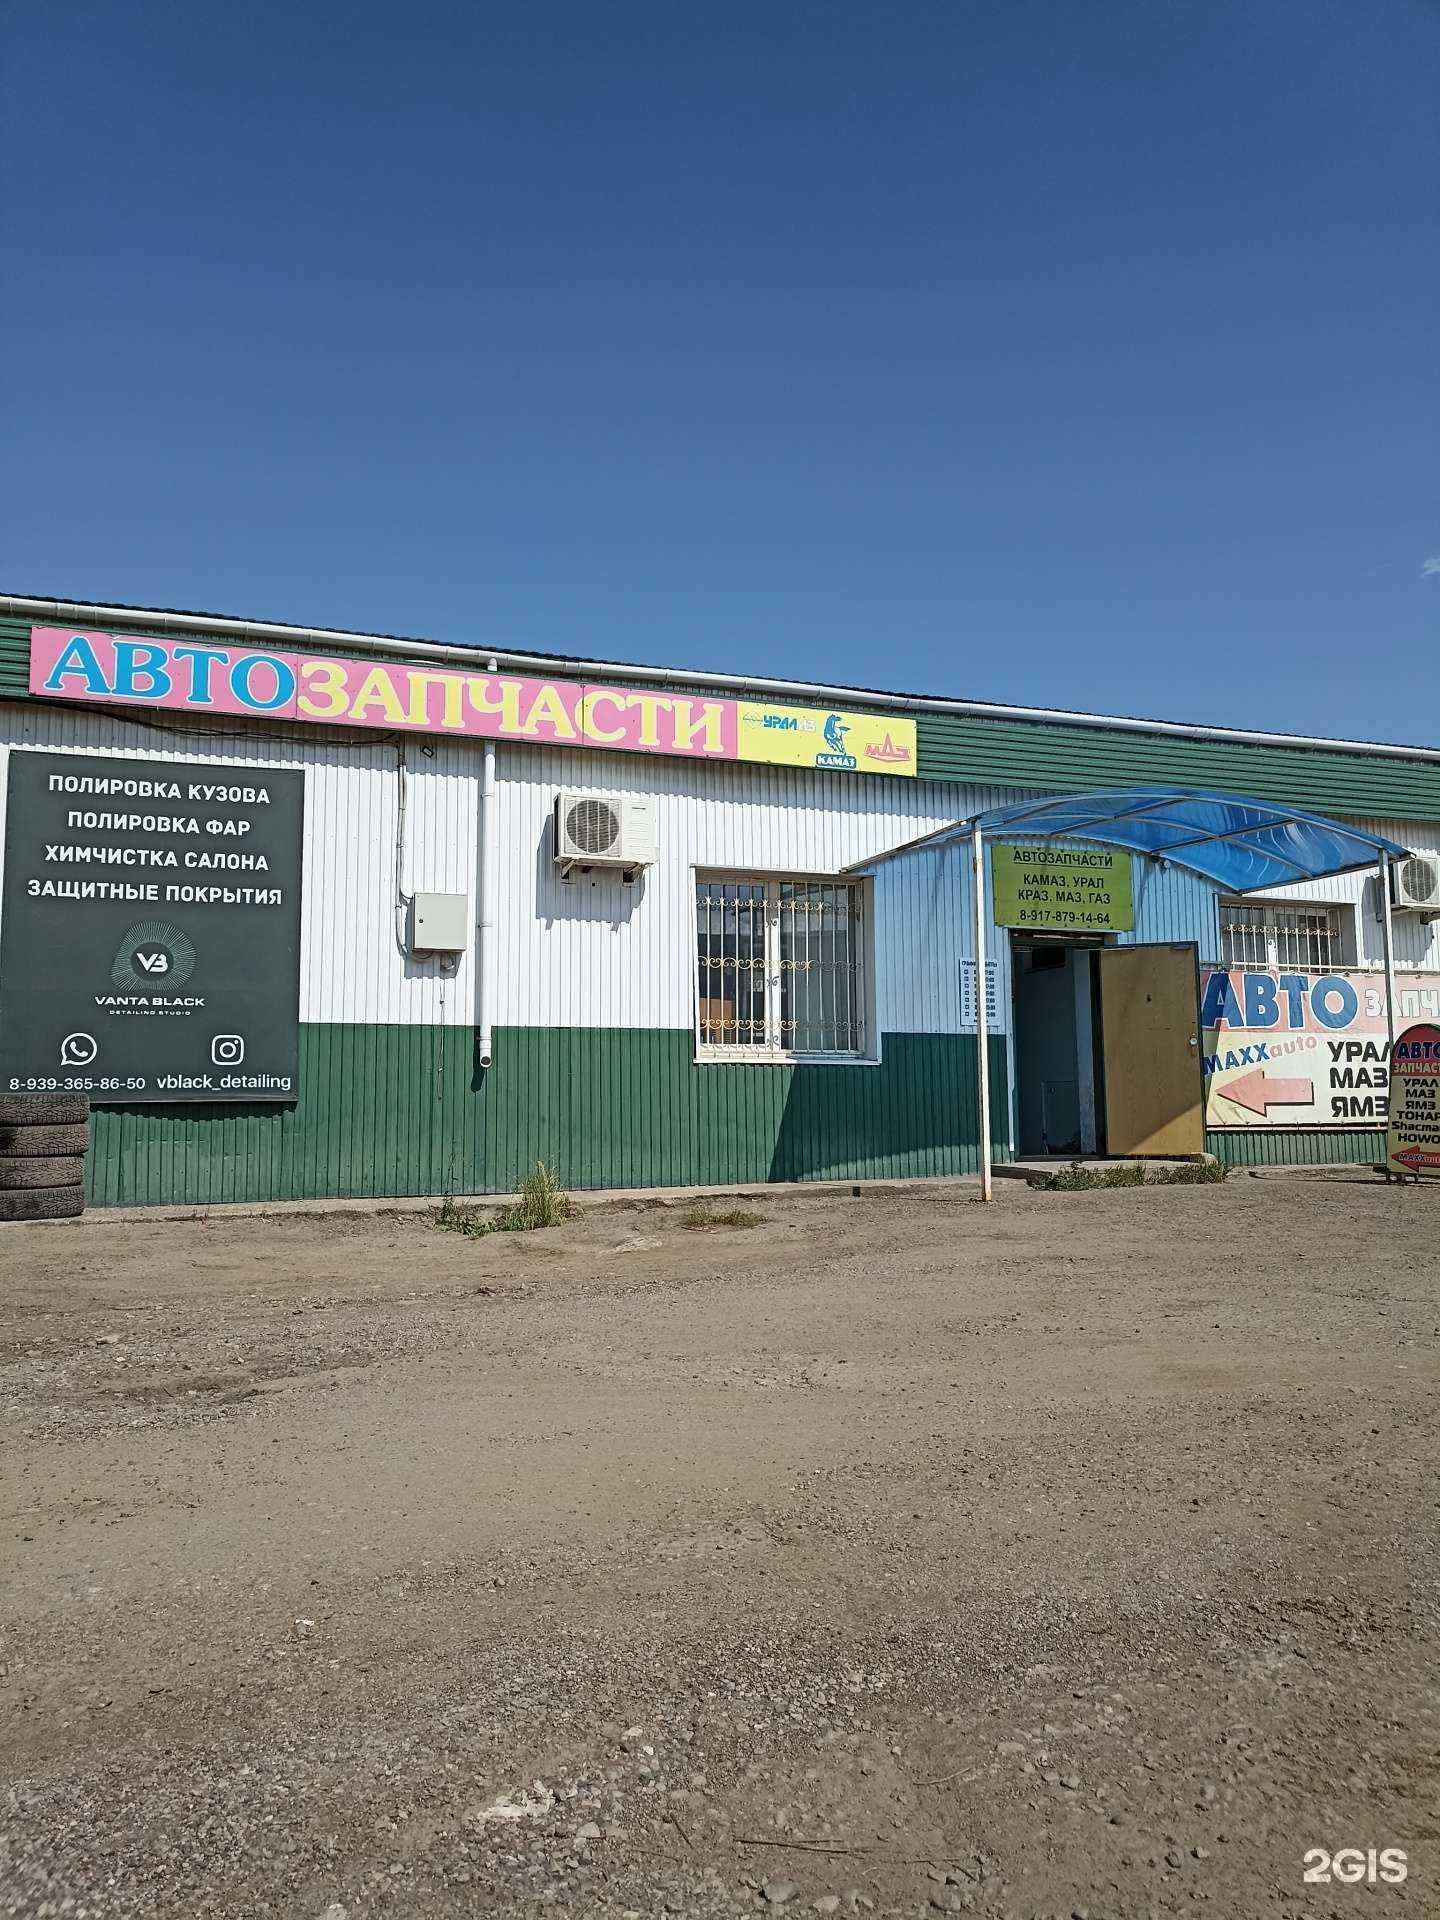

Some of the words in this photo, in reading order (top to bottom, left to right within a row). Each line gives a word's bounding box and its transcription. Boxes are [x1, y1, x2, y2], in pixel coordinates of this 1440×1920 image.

[817, 755, 855, 767] КАМАЗ
[49, 774, 182, 800] ПОЛИРОВКА
[188, 784, 271, 804] КУЗОВА
[68, 811, 200, 834] ПОЛИРОВКА
[206, 819, 250, 836] ФАР
[44, 845, 179, 867] ХИМЧИСТКА
[184, 852, 269, 871] САЛОНА
[1013, 850, 1113, 868] АВТОЗАПЧАСТИ
[1073, 877, 1104, 889] УРАЛ
[28, 879, 159, 901] ЗАЩИТНЫЕ
[166, 885, 282, 905] ПОКРЫТИЯ
[1089, 893, 1111, 905] ГАЗ
[1019, 909, 1110, 924] 8-917-879-14-64
[94, 996, 149, 1006] VANTA
[152, 997, 205, 1007] BLACK
[1202, 971, 1359, 1030] АВТО
[9, 1077, 146, 1090] 8-939-365-86-50
[157, 1073, 292, 1091] vblack_detailing
[1330, 1067, 1389, 1089] МАЗ
[1403, 1079, 1439, 1088] УРАЛ
[1405, 1089, 1436, 1099] МАЗ
[1330, 1096, 1389, 1118] ЯМЗ
[1405, 1101, 1436, 1111] ЯМЗ
[1397, 1133, 1440, 1144] HOWO
